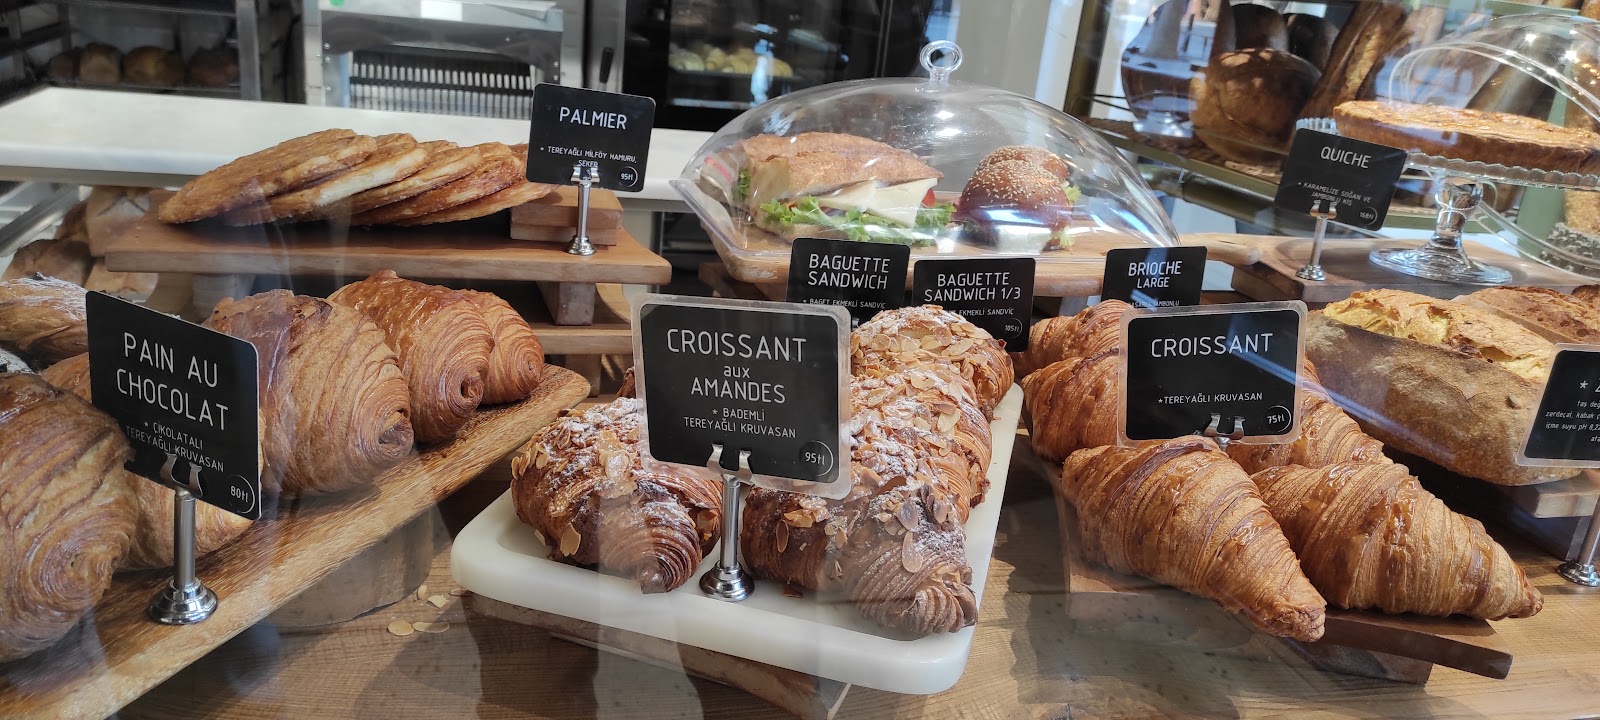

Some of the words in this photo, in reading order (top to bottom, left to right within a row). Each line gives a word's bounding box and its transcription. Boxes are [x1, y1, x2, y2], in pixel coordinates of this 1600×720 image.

[559, 106, 628, 130] PALMIER
[547, 146, 583, 157] TEREYAĞLI
[1320, 146, 1372, 169] QUICHE
[1340, 190, 1361, 201] SOĞAN
[809, 253, 891, 274] BAGUETTE
[1128, 261, 1183, 276] BRIOCHE
[807, 270, 888, 290] SANDWICH
[937, 272, 1011, 287] BAGUETTE
[1137, 277, 1170, 289] LARGE
[924, 288, 995, 302] SANDWICH
[1001, 286, 1021, 300] 1/3
[667, 328, 807, 363] CROISSANT
[1151, 333, 1274, 358] CROISSANT
[123, 331, 174, 374] PAIN
[187, 355, 218, 388] AU
[723, 365, 750, 379] aux
[116, 368, 229, 431] CHOCOLAT
[691, 377, 786, 404] AMANDES
[1214, 392, 1263, 402] KRUVASAN
[722, 407, 766, 422] BADEMLİ
[1576, 411, 1595, 419] kabak
[153, 421, 203, 450] ÇİKOLATALI
[684, 416, 736, 433] TEREYAĞLI
[740, 422, 796, 439] KRUVASAN
[1561, 423, 1577, 431] suyu
[1578, 423, 1588, 431] pH
[126, 425, 171, 452] TEREYAĞLI
[174, 444, 224, 473] KRUVASAN
